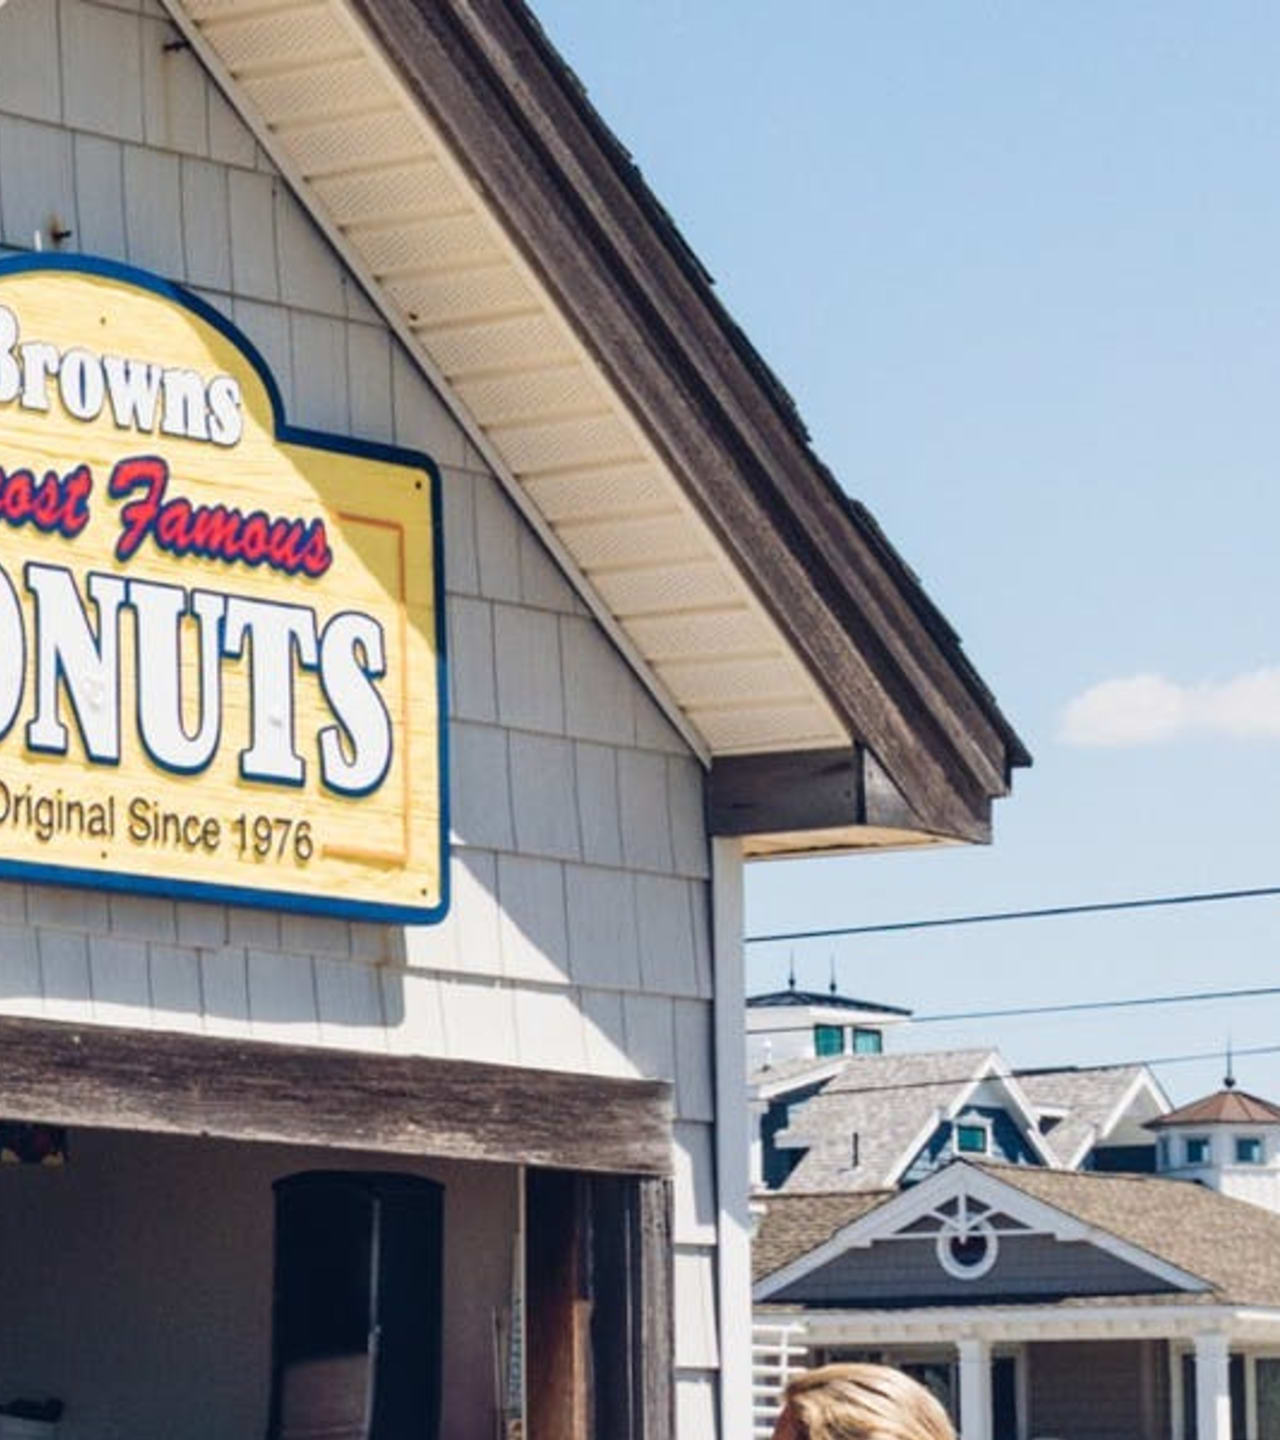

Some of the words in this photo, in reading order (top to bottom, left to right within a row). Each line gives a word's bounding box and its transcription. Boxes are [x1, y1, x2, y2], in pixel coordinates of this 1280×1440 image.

[109, 455, 333, 578] Famous
[128, 797, 221, 849] Since
[235, 812, 314, 861] 1976
